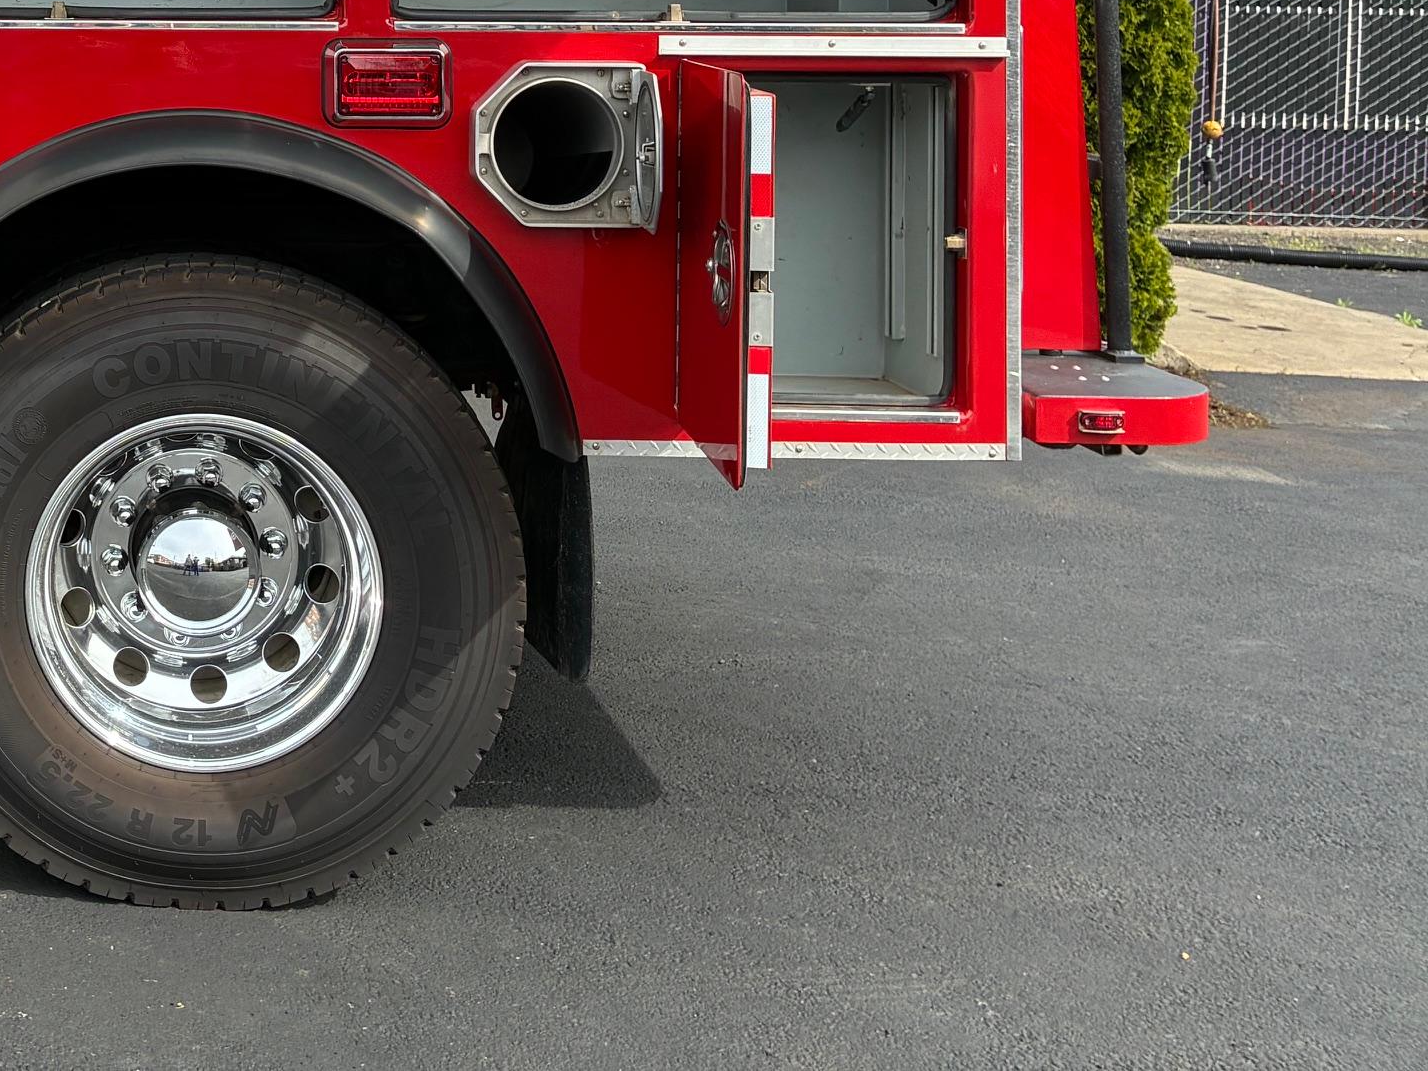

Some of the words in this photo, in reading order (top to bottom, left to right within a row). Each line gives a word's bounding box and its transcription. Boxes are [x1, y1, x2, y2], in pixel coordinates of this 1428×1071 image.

[92, 338, 452, 535] CONTINENTAL
[28, 760, 114, 823] 22.5
[128, 806, 156, 841] R
[172, 817, 212, 846] 12
